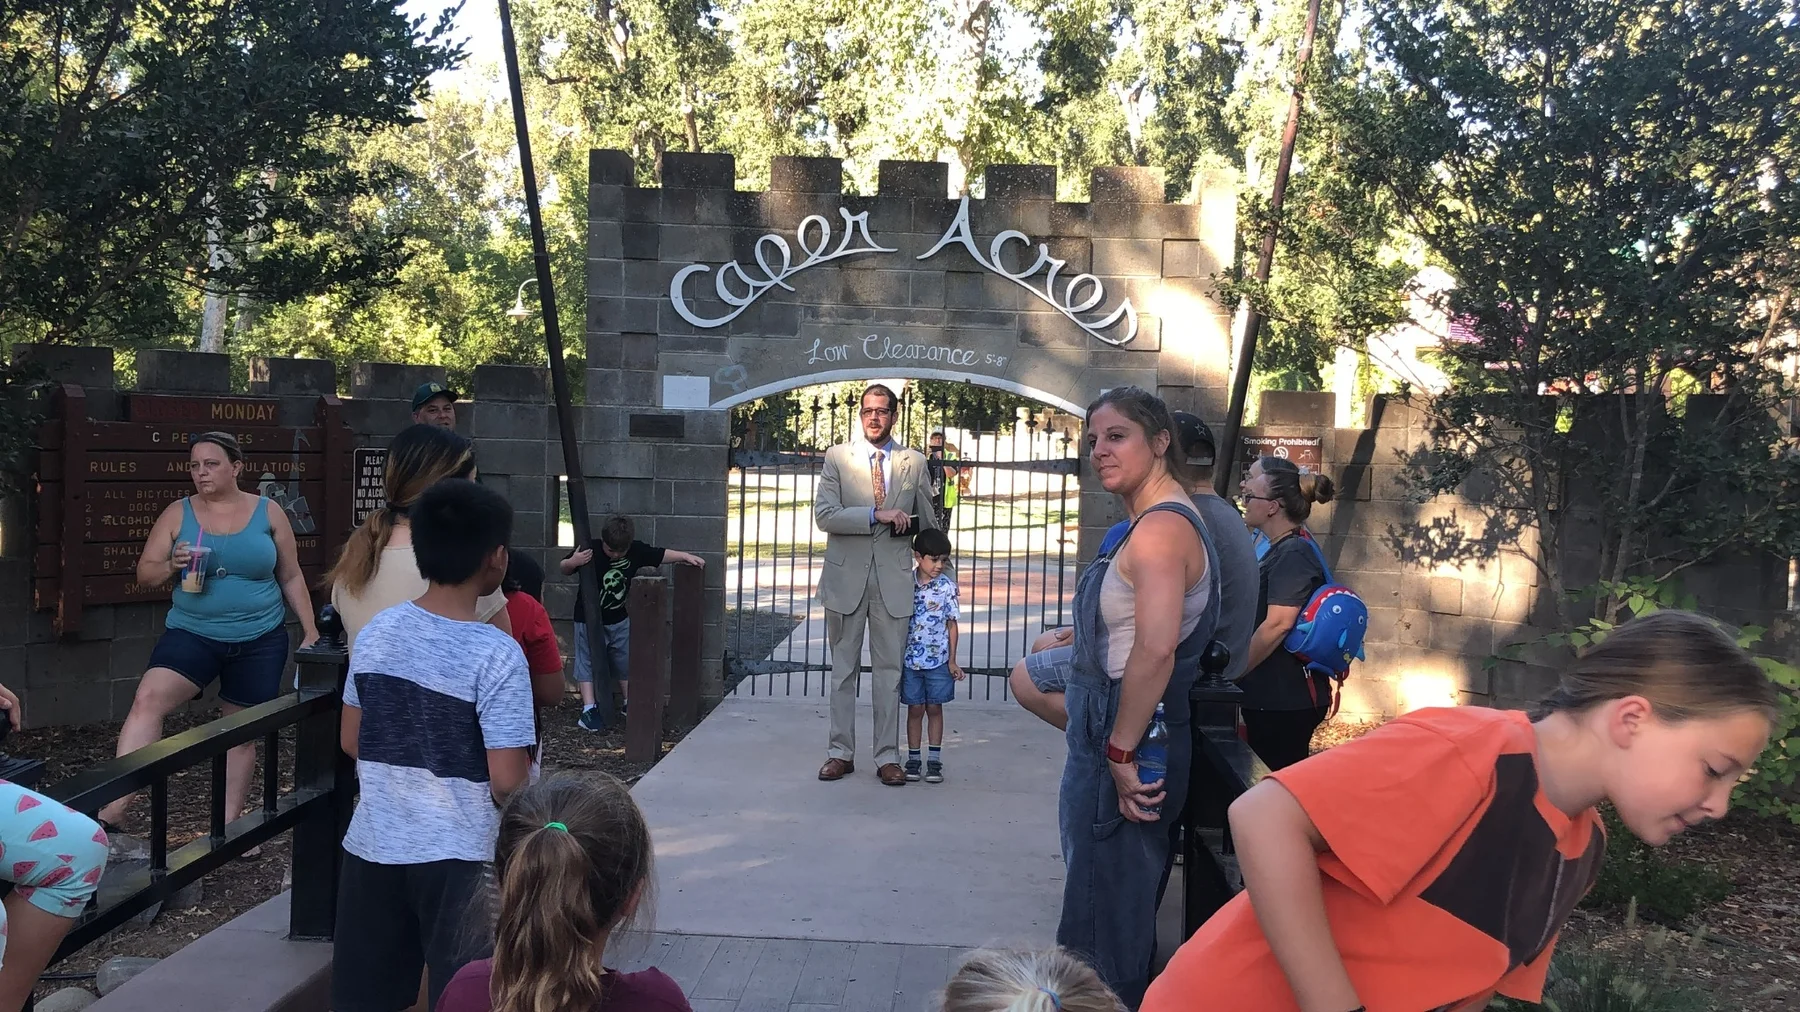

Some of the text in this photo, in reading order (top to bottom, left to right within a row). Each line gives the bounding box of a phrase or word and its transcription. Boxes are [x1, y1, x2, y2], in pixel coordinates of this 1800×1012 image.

[916, 195, 1138, 345] Acres
[803, 338, 850, 365] Low
[857, 334, 980, 366] Clearance
[211, 403, 275, 421] MONDAY
[1244, 437, 1277, 447] Smoking
[365, 456, 384, 465] PLEAS
[90, 461, 306, 473] RULES AND ULATIONS
[362, 466, 382, 476] NO DO
[361, 477, 384, 487] NO GLA
[104, 490, 126, 499] ALL
[137, 489, 191, 499] BICYCLES
[357, 488, 384, 498] NO ALCO
[129, 503, 158, 512] DOGS
[356, 499, 364, 509] NO
[103, 546, 141, 556] SHALL
[103, 560, 118, 570] BY
